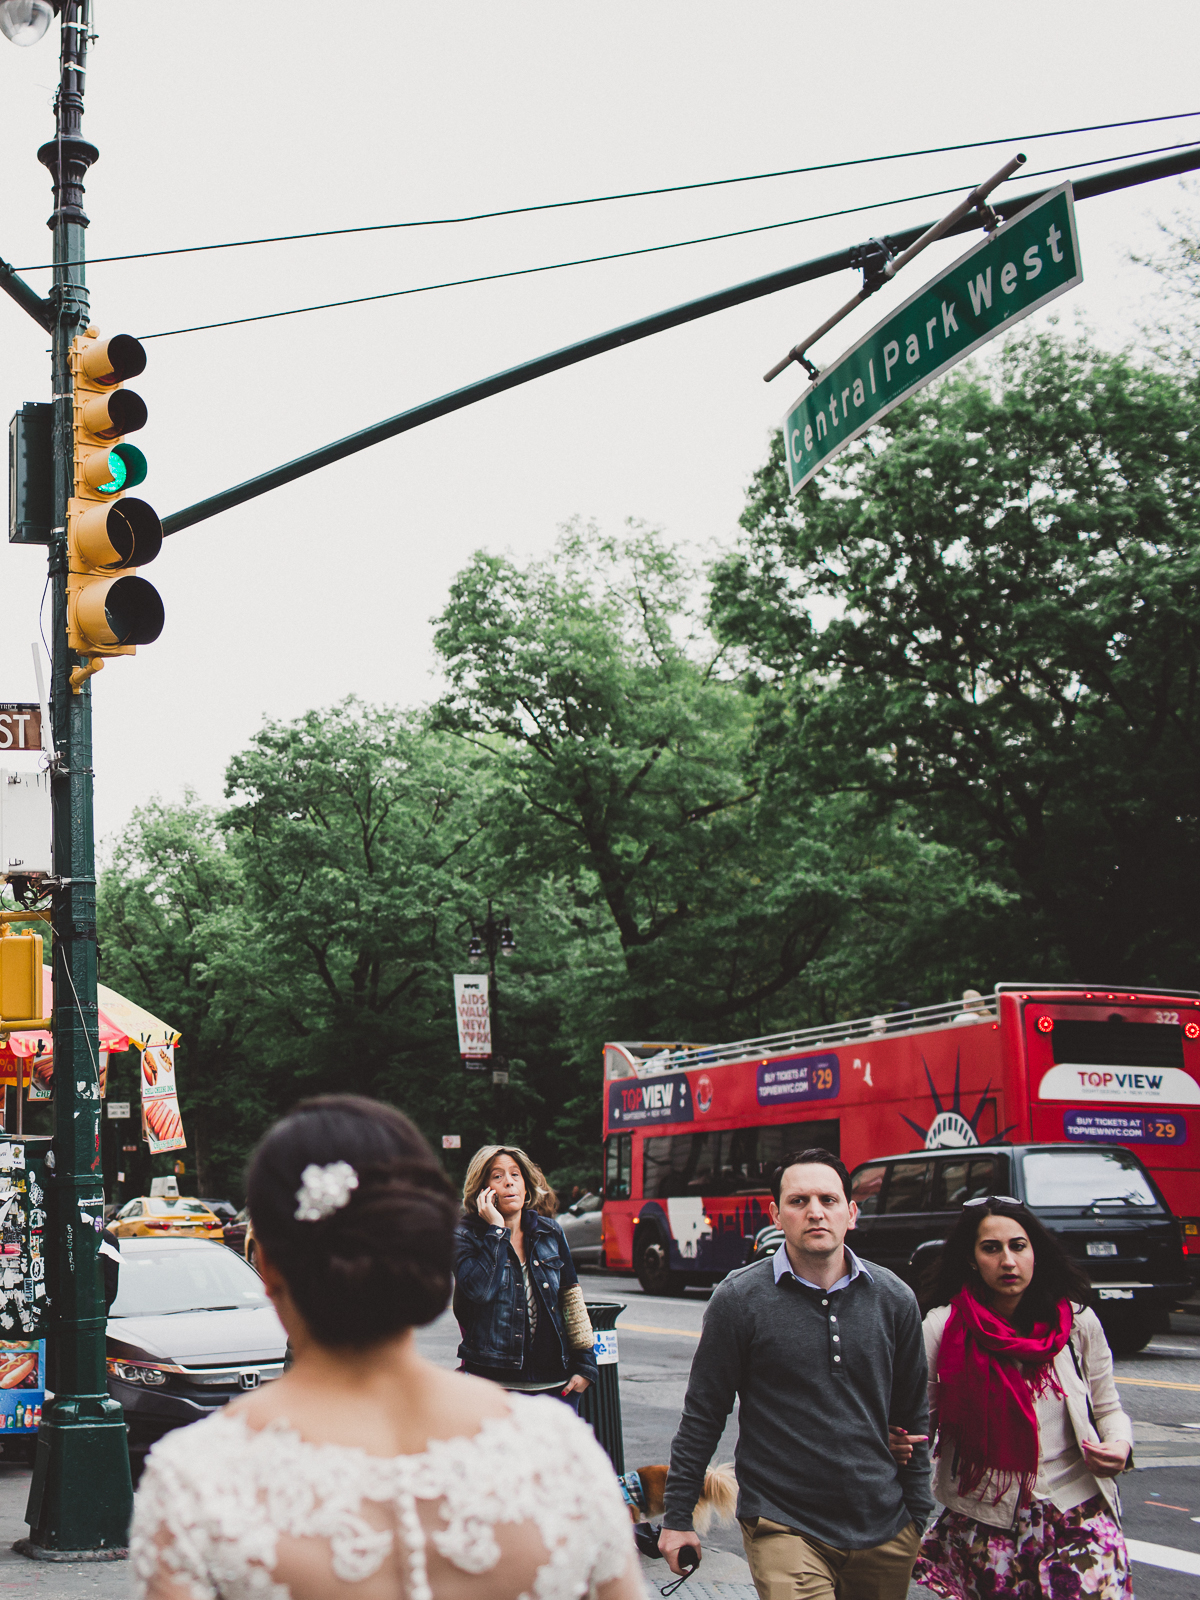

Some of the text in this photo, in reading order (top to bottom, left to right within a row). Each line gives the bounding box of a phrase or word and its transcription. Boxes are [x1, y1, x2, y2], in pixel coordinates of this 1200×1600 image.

[791, 223, 1064, 464] Central Park West
[461, 994, 487, 1005] AIDS
[458, 1006, 490, 1018] WALK
[1155, 1011, 1180, 1025] 322
[462, 1019, 487, 1031] NEW
[764, 1067, 808, 1084] BUY TICKETS AT
[758, 1081, 809, 1097] TOPVIEWNYC.COM
[621, 1083, 674, 1112] TOPVIEW
[1076, 1116, 1141, 1127] BUY TICKETS AT
[1067, 1126, 1143, 1137] TOPVIEWNYC.COM
